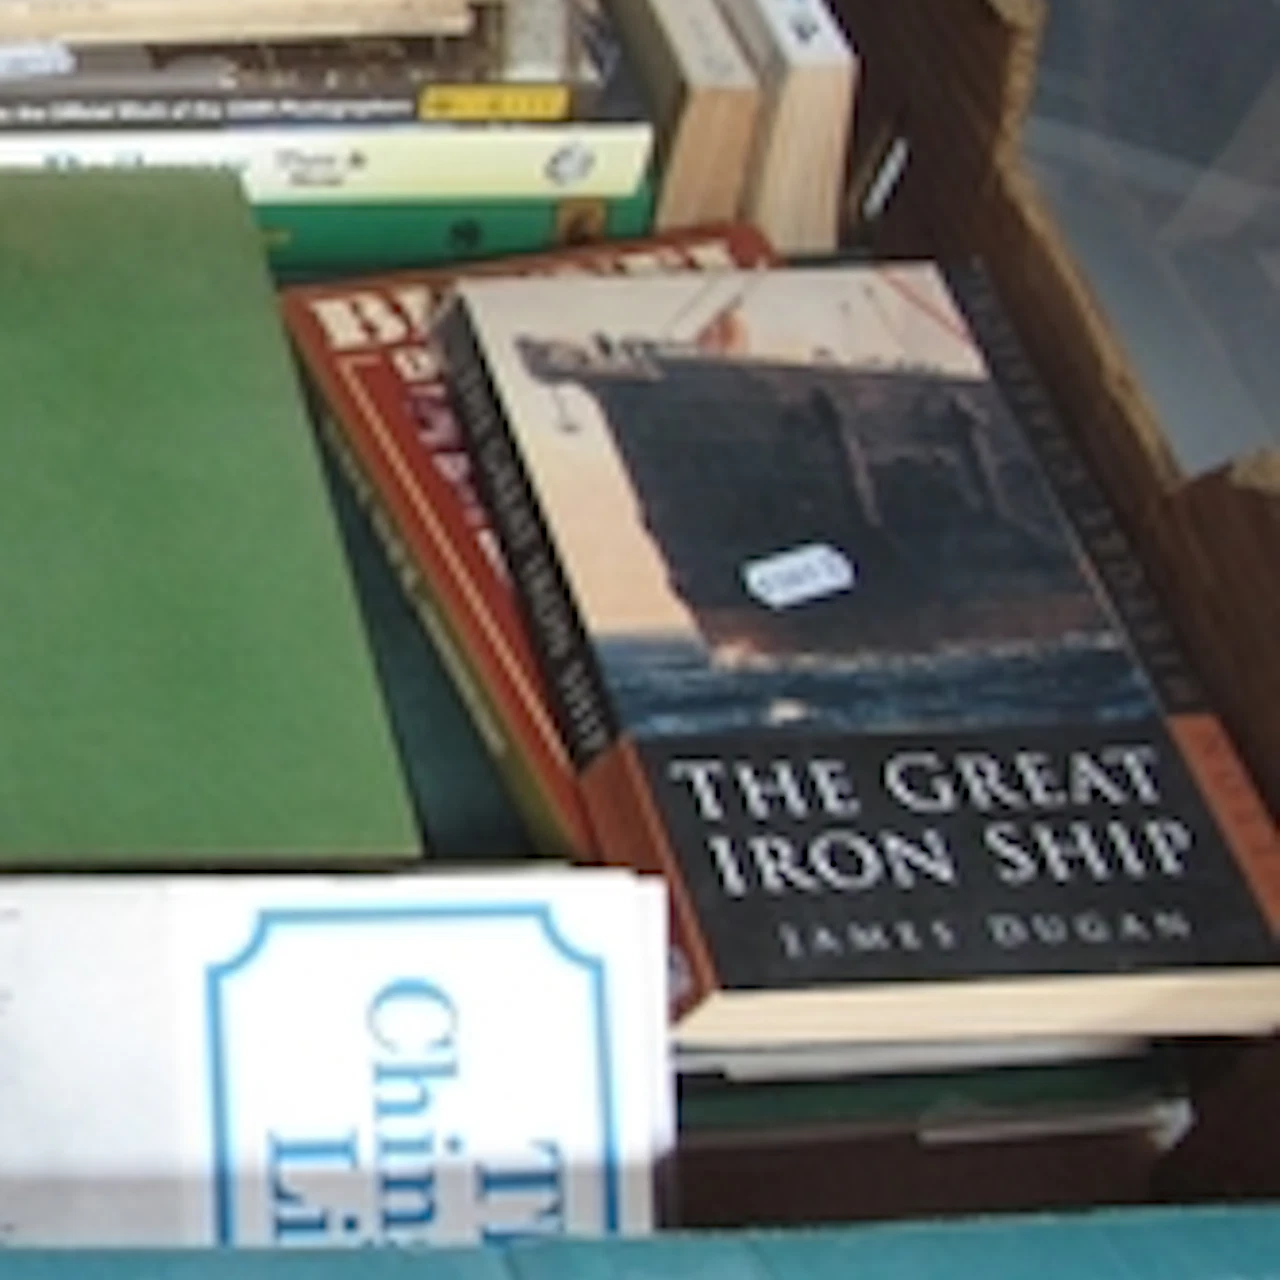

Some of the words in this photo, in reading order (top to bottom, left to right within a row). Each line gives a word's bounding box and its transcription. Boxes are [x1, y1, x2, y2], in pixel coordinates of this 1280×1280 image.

[669, 754, 862, 823] THE
[884, 744, 1167, 813] GREAT
[707, 828, 957, 898] IRON
[984, 819, 1193, 886] SHIP
[779, 917, 960, 960] JAMES
[989, 909, 1192, 950] DUGAN
